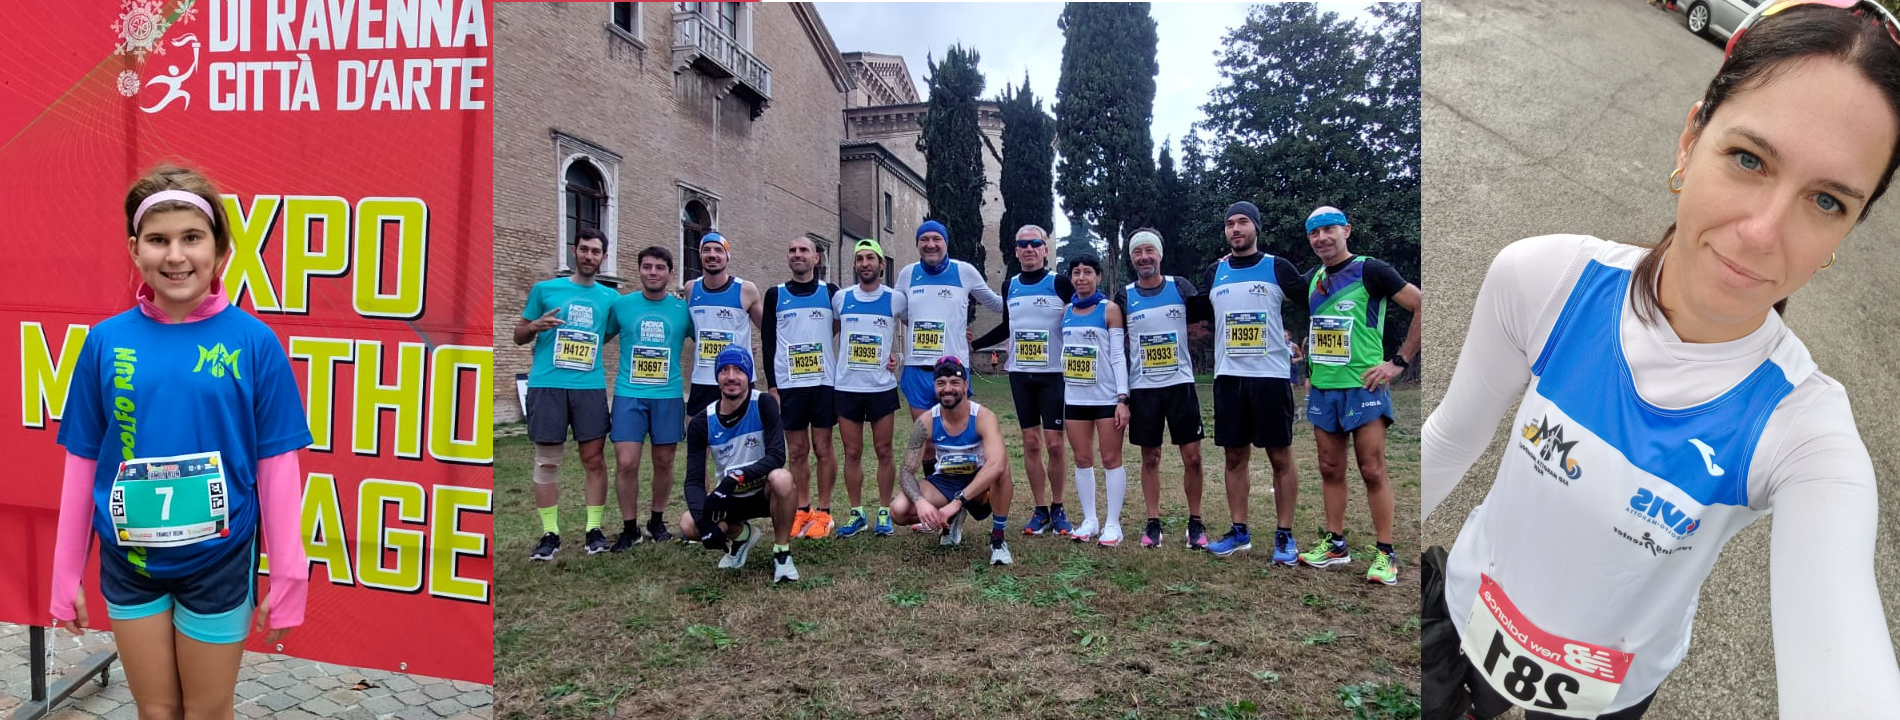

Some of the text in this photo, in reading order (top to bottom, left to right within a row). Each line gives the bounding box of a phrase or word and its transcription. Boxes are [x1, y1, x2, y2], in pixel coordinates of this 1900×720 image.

[209, 0, 488, 52] DI RAVENNA
[209, 53, 487, 112] CITTÀ D'ARTE
[220, 194, 428, 319] XPO
[916, 333, 938, 345] H3940
[1231, 327, 1259, 342] H3937
[1317, 333, 1342, 348] H4514
[563, 343, 590, 357] H4127
[853, 346, 876, 359] H3939
[1020, 344, 1042, 356] H3934
[1146, 346, 1172, 361] H3933
[638, 359, 662, 373] H3697
[795, 355, 818, 368] H3254
[1067, 359, 1091, 372] H3938
[113, 347, 138, 392] RUN
[113, 396, 137, 462] DOLFO
[155, 486, 174, 521] 7
[172, 529, 184, 537] RUN
